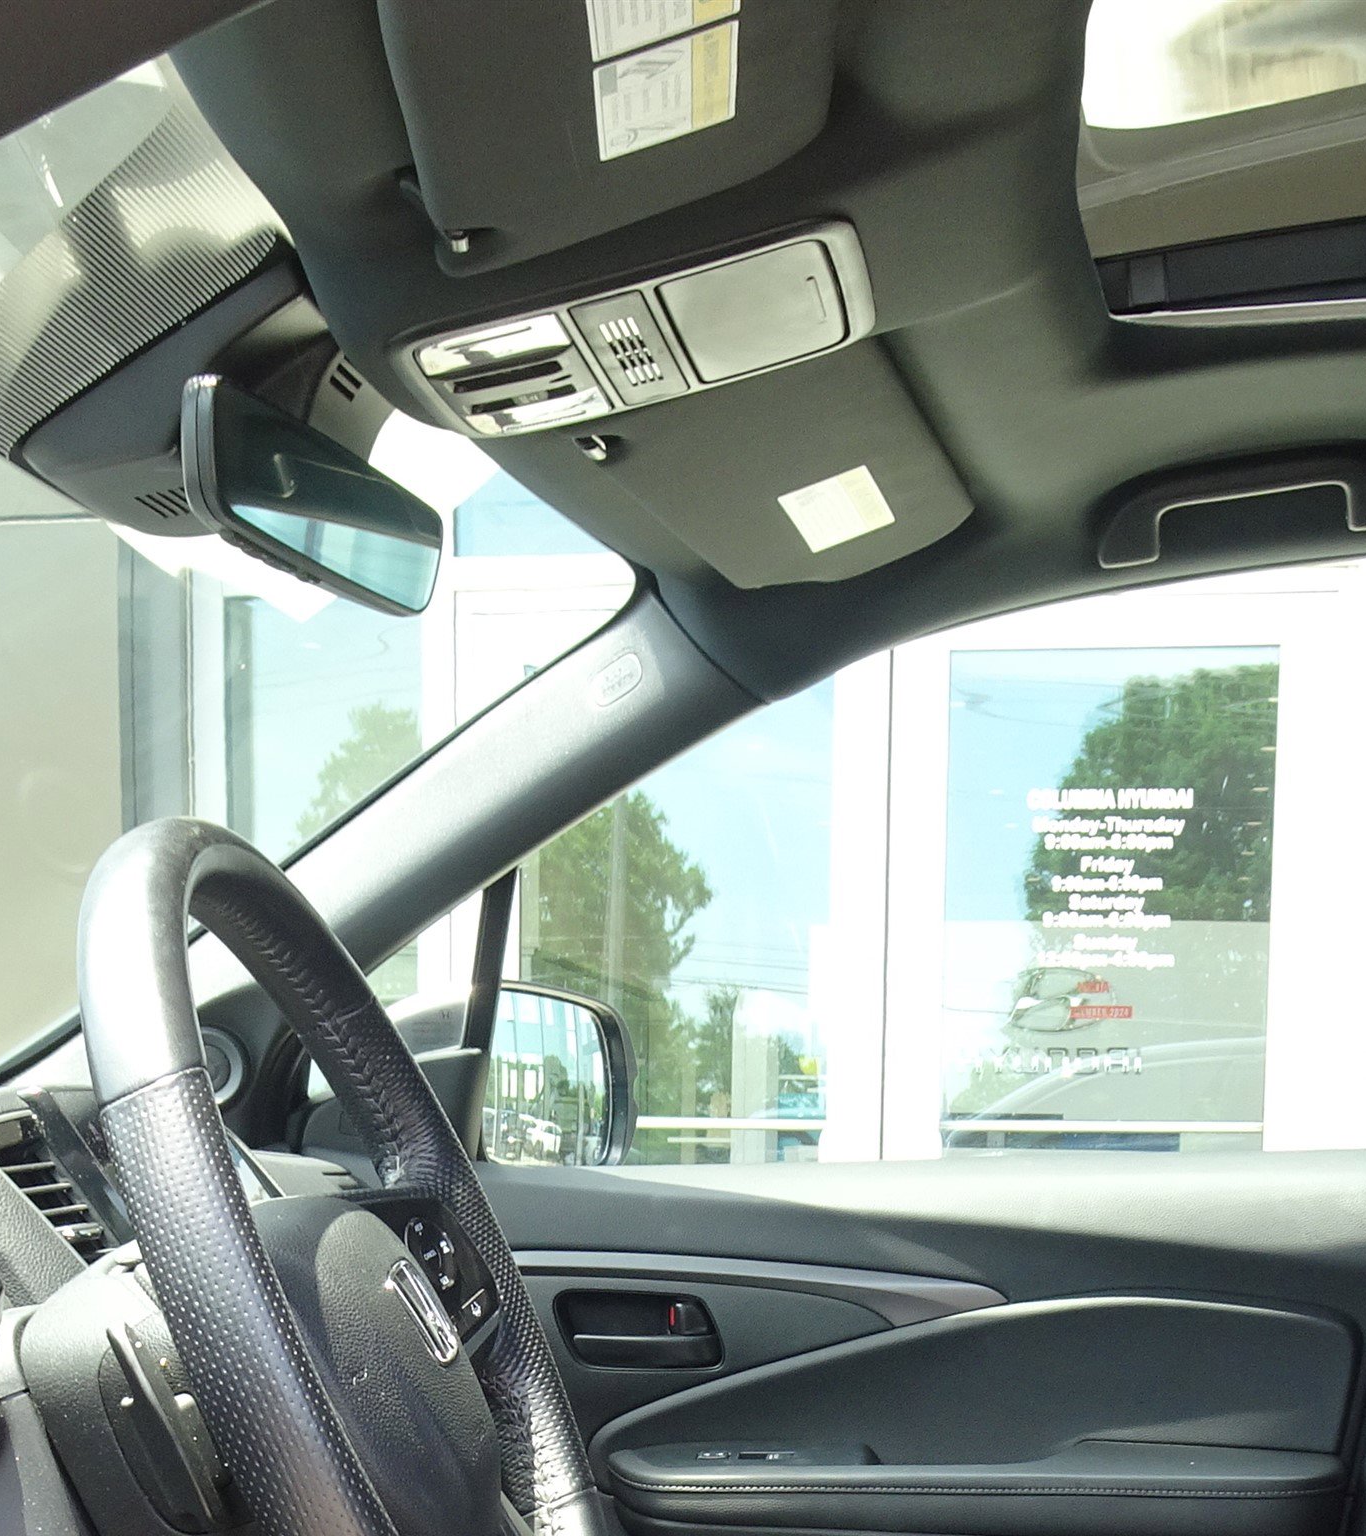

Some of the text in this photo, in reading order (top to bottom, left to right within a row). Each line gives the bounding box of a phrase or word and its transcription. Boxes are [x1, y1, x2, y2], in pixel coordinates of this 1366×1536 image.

[1117, 788, 1194, 809] HYUNDAI
[1032, 816, 1185, 836] Monday-Thursday
[1081, 857, 1134, 876] Friday
[1069, 894, 1145, 914] Saturday
[1073, 934, 1138, 954] Sunday
